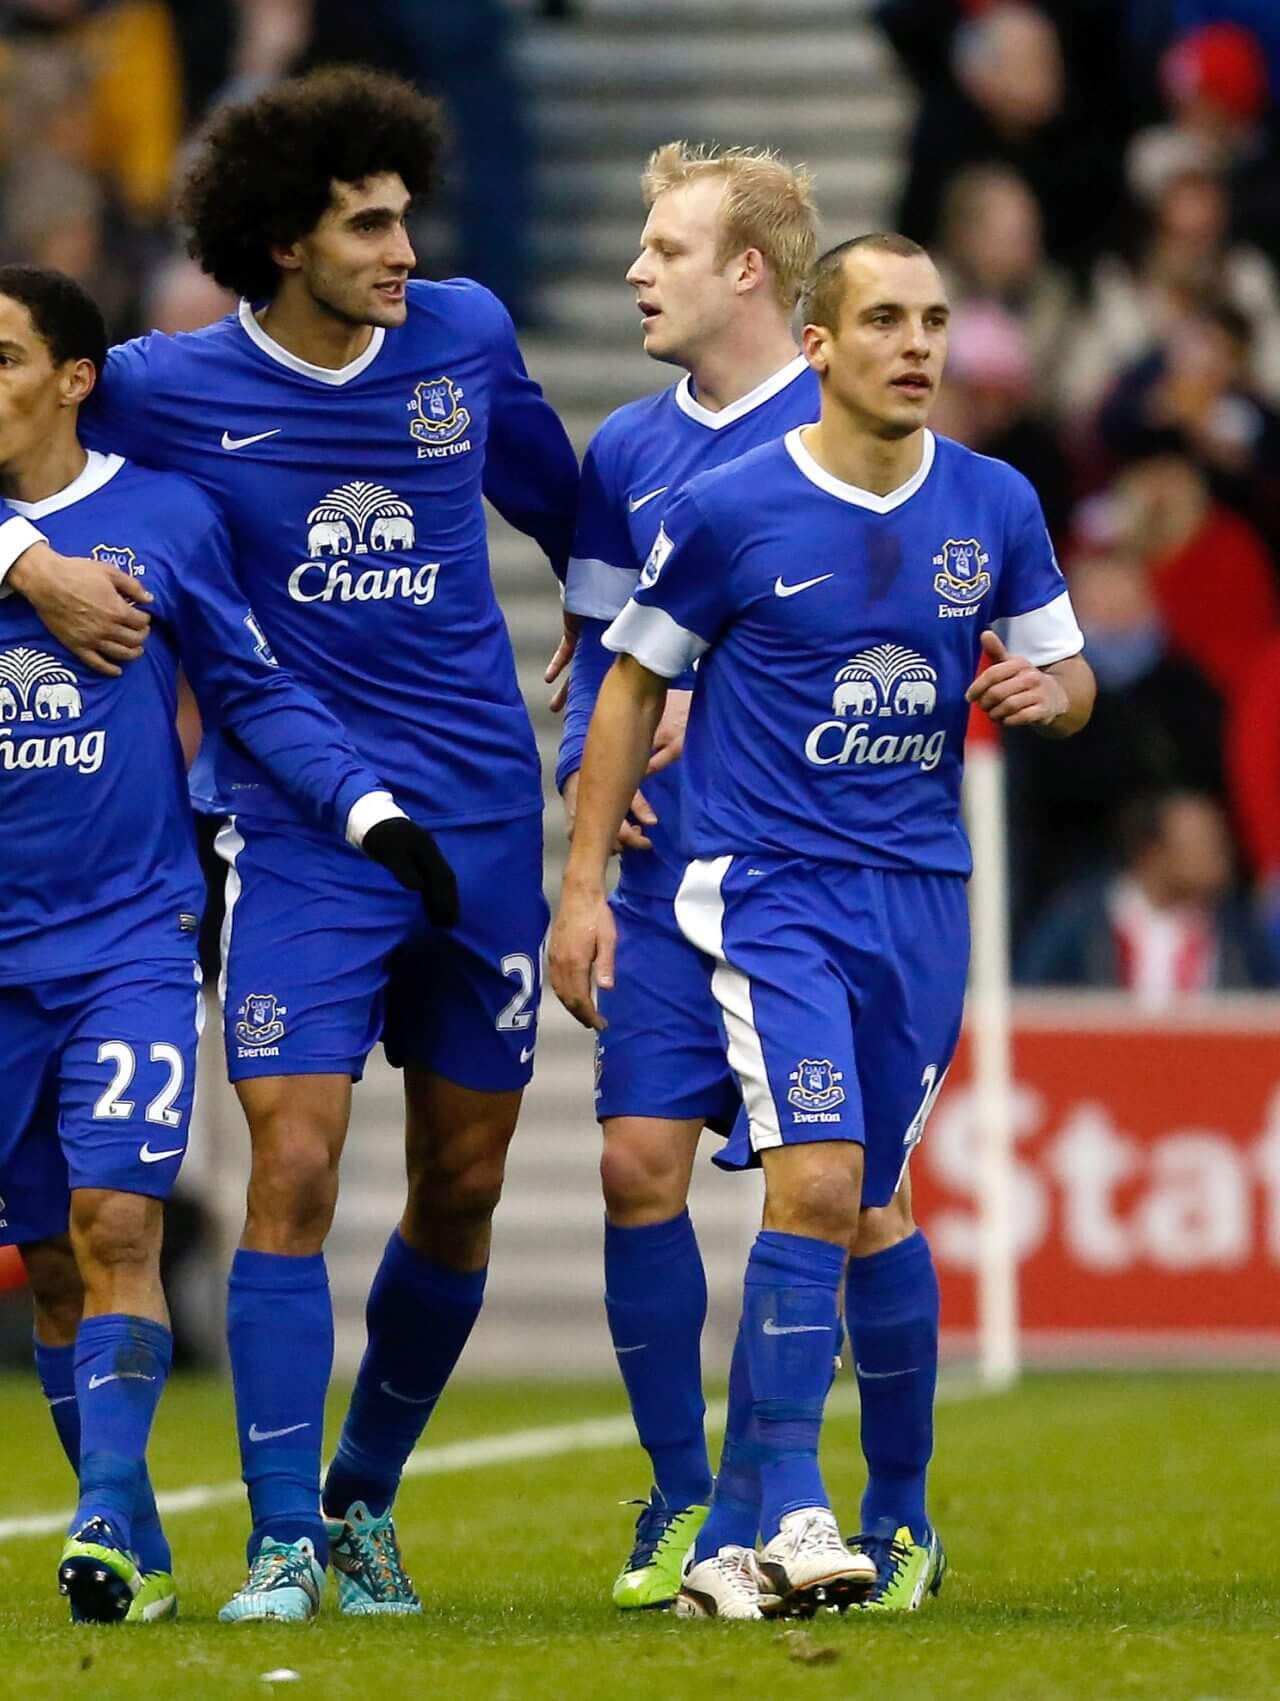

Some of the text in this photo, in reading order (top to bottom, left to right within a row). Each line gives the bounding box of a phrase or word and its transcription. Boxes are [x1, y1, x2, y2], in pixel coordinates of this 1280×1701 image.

[417, 439, 471, 458] Everton
[287, 560, 441, 605] Chang
[804, 720, 946, 771] Chang
[237, 1046, 280, 1058] Everton
[93, 1040, 185, 1129] 22
[792, 1111, 841, 1123] Everton
